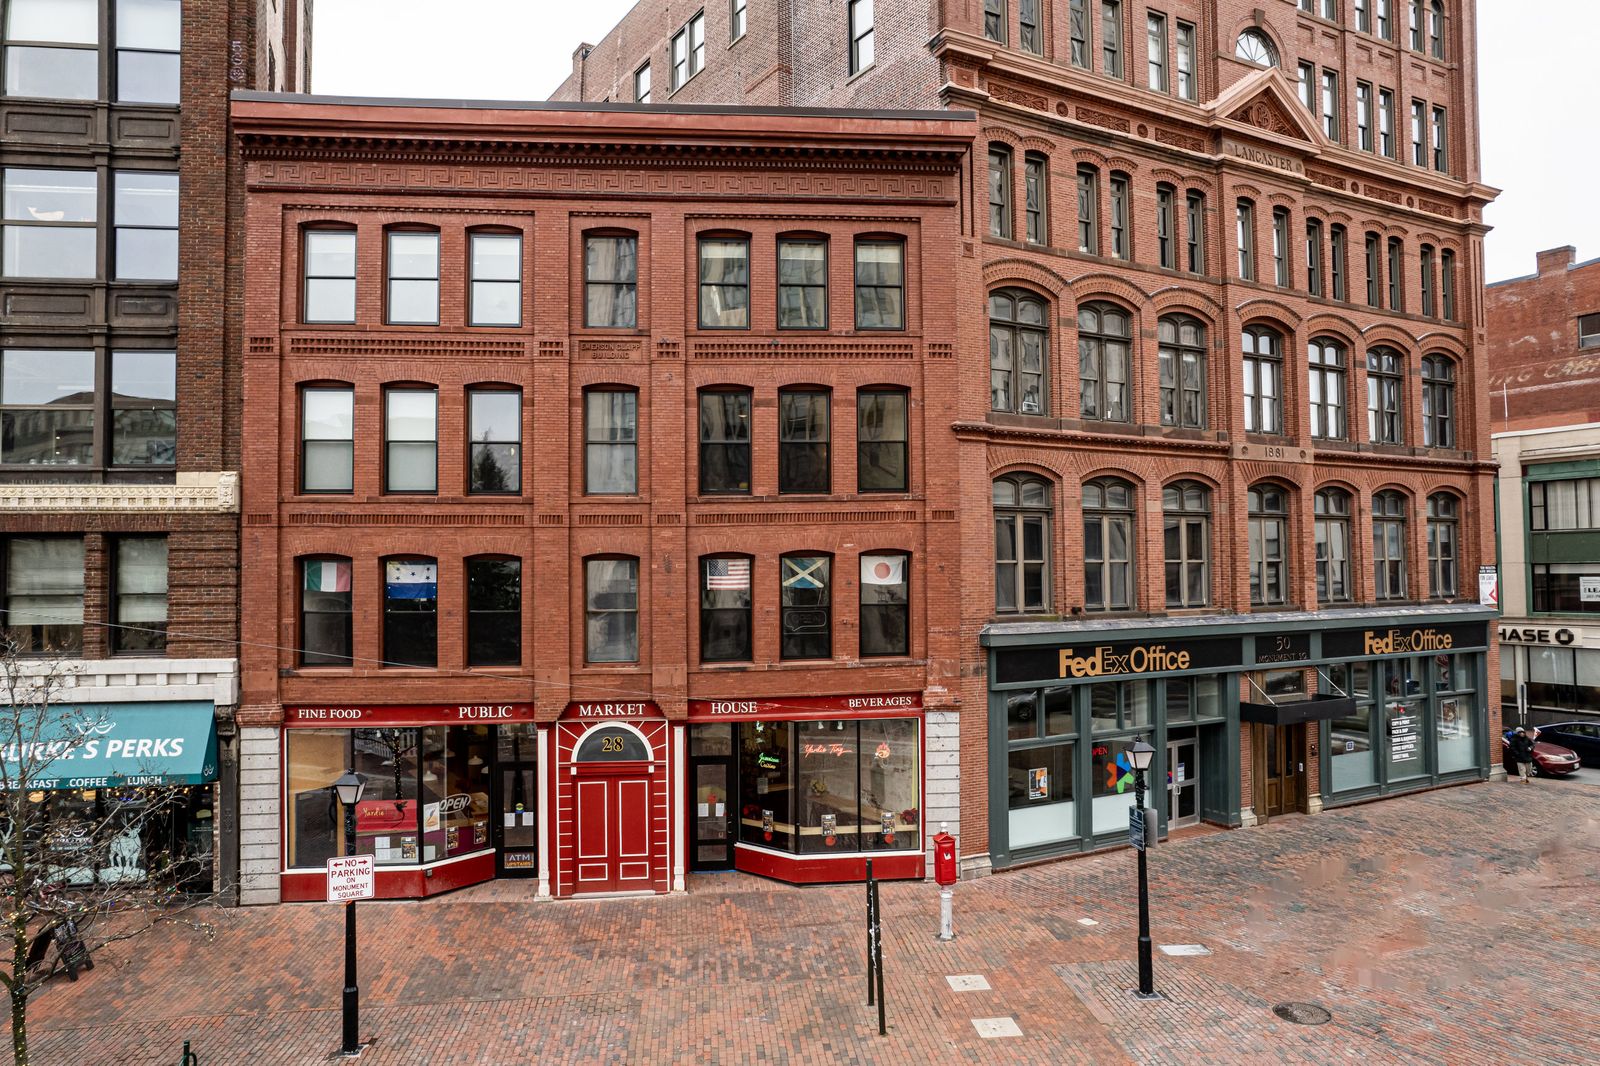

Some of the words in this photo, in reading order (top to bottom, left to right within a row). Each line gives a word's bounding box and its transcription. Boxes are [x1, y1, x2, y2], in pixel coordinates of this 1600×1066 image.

[1234, 145, 1293, 172] LANCASTER
[581, 343, 614, 351] EMERSON
[592, 351, 630, 359] BUILDING
[1264, 447, 1285, 458] 1881
[1276, 636, 1291, 651] 50
[1364, 629, 1411, 655] FedEx
[1411, 628, 1452, 651] Office
[1059, 646, 1130, 678] FedEx
[1130, 645, 1190, 673] Office
[1257, 653, 1296, 663] MONUMENT
[711, 702, 758, 714] HOUSE
[848, 696, 912, 708] BEVERAGES
[298, 709, 327, 719] FINE
[330, 709, 362, 719] FOOD
[458, 706, 513, 718] PUBLIC
[579, 704, 646, 716] MARKET
[105, 737, 184, 759] PERKS
[602, 737, 624, 751] 28
[0, 779, 60, 790] BREKFAST
[69, 777, 108, 787] COFFEE
[127, 776, 162, 786] LUNCH
[440, 797, 468, 810] OPEN
[344, 859, 357, 867] NO
[509, 853, 531, 861] ATM
[331, 867, 370, 878] PARKING
[332, 883, 369, 892] MONUMENT
[337, 890, 364, 899] SQUARE
